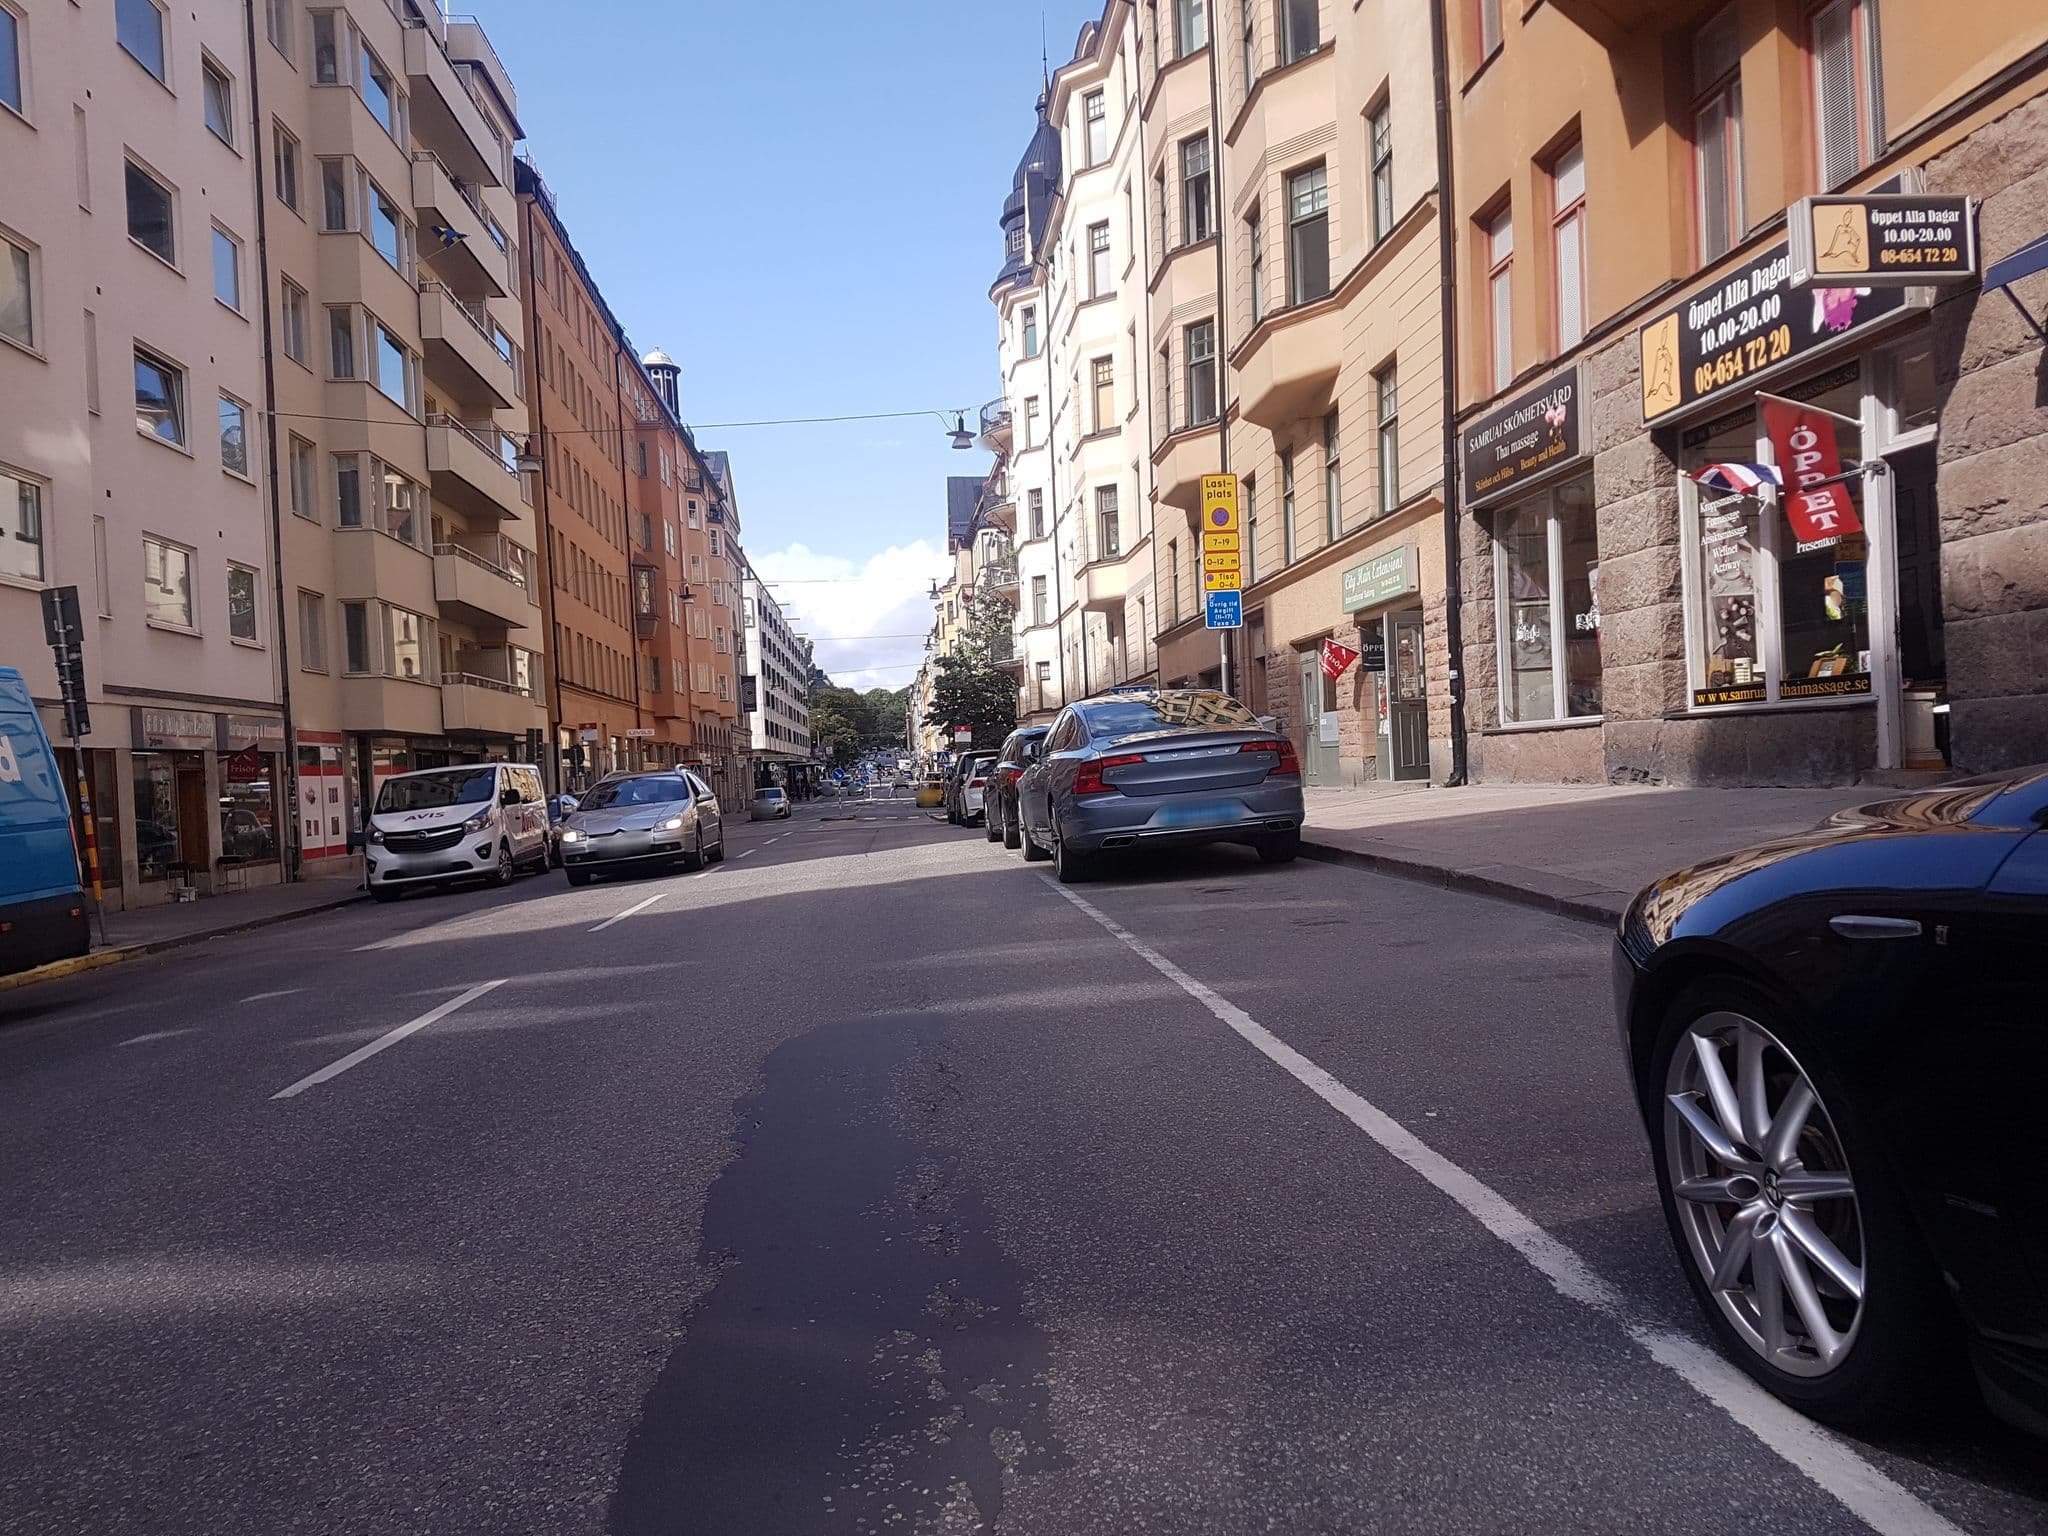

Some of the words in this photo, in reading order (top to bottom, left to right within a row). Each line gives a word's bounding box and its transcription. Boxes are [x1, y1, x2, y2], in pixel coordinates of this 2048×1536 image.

[1871, 209, 1902, 225] Öppet
[1904, 209, 1926, 223] Alla
[1928, 209, 1960, 224] Dagar
[1884, 228, 1951, 242] 10.00-20.00
[1881, 248, 1922, 264] 08-654
[1924, 248, 1940, 262] 72
[1942, 248, 1957, 262] 20
[1688, 294, 1722, 331] Öppet
[1724, 277, 1749, 314] Alla
[1700, 294, 1781, 356] 10.00-20.00
[1695, 344, 1744, 395] 08-654
[1746, 335, 1766, 371] 72
[1769, 323, 1791, 360] 20
[1503, 384, 1572, 435] SKÖNHETSVÅRD
[1495, 442, 1510, 461] Thai
[1510, 430, 1539, 454] massage
[1790, 425, 1839, 532] ÖPPET
[1207, 489, 1232, 501] plats
[1213, 538, 1230, 546] 7-19
[1206, 558, 1224, 566] 0-12
[1219, 573, 1235, 581] Tisd
[1362, 643, 1384, 652] ÖPPE
[1780, 678, 1868, 697] thaimassage.se
[404, 810, 445, 823] AVIS
